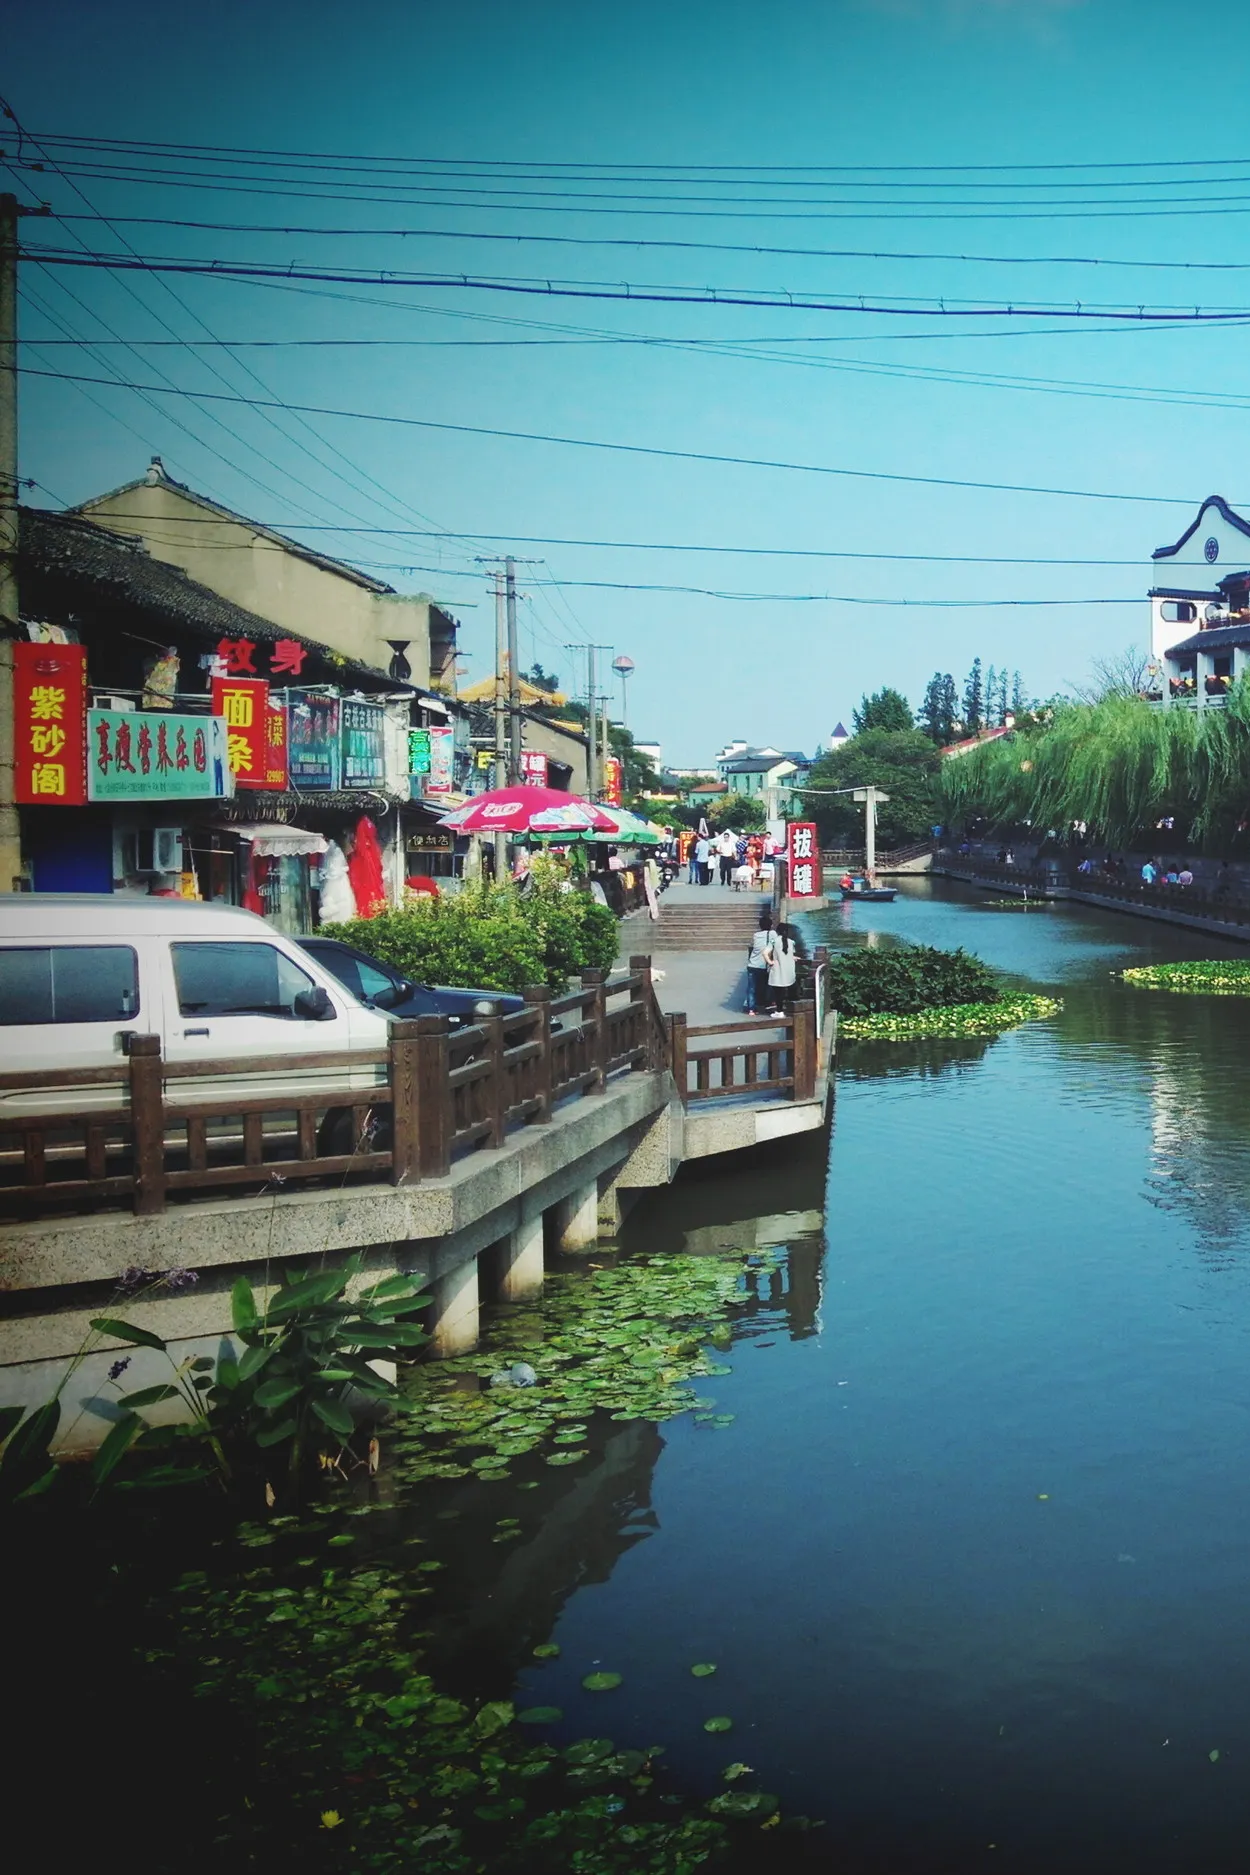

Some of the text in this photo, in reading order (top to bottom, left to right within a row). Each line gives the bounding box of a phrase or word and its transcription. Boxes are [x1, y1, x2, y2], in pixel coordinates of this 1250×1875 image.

[217, 637, 308, 675] 纹身
[29, 685, 66, 796] 紫砂阁
[221, 688, 254, 773] 面条
[793, 829, 813, 895] 拔罐
